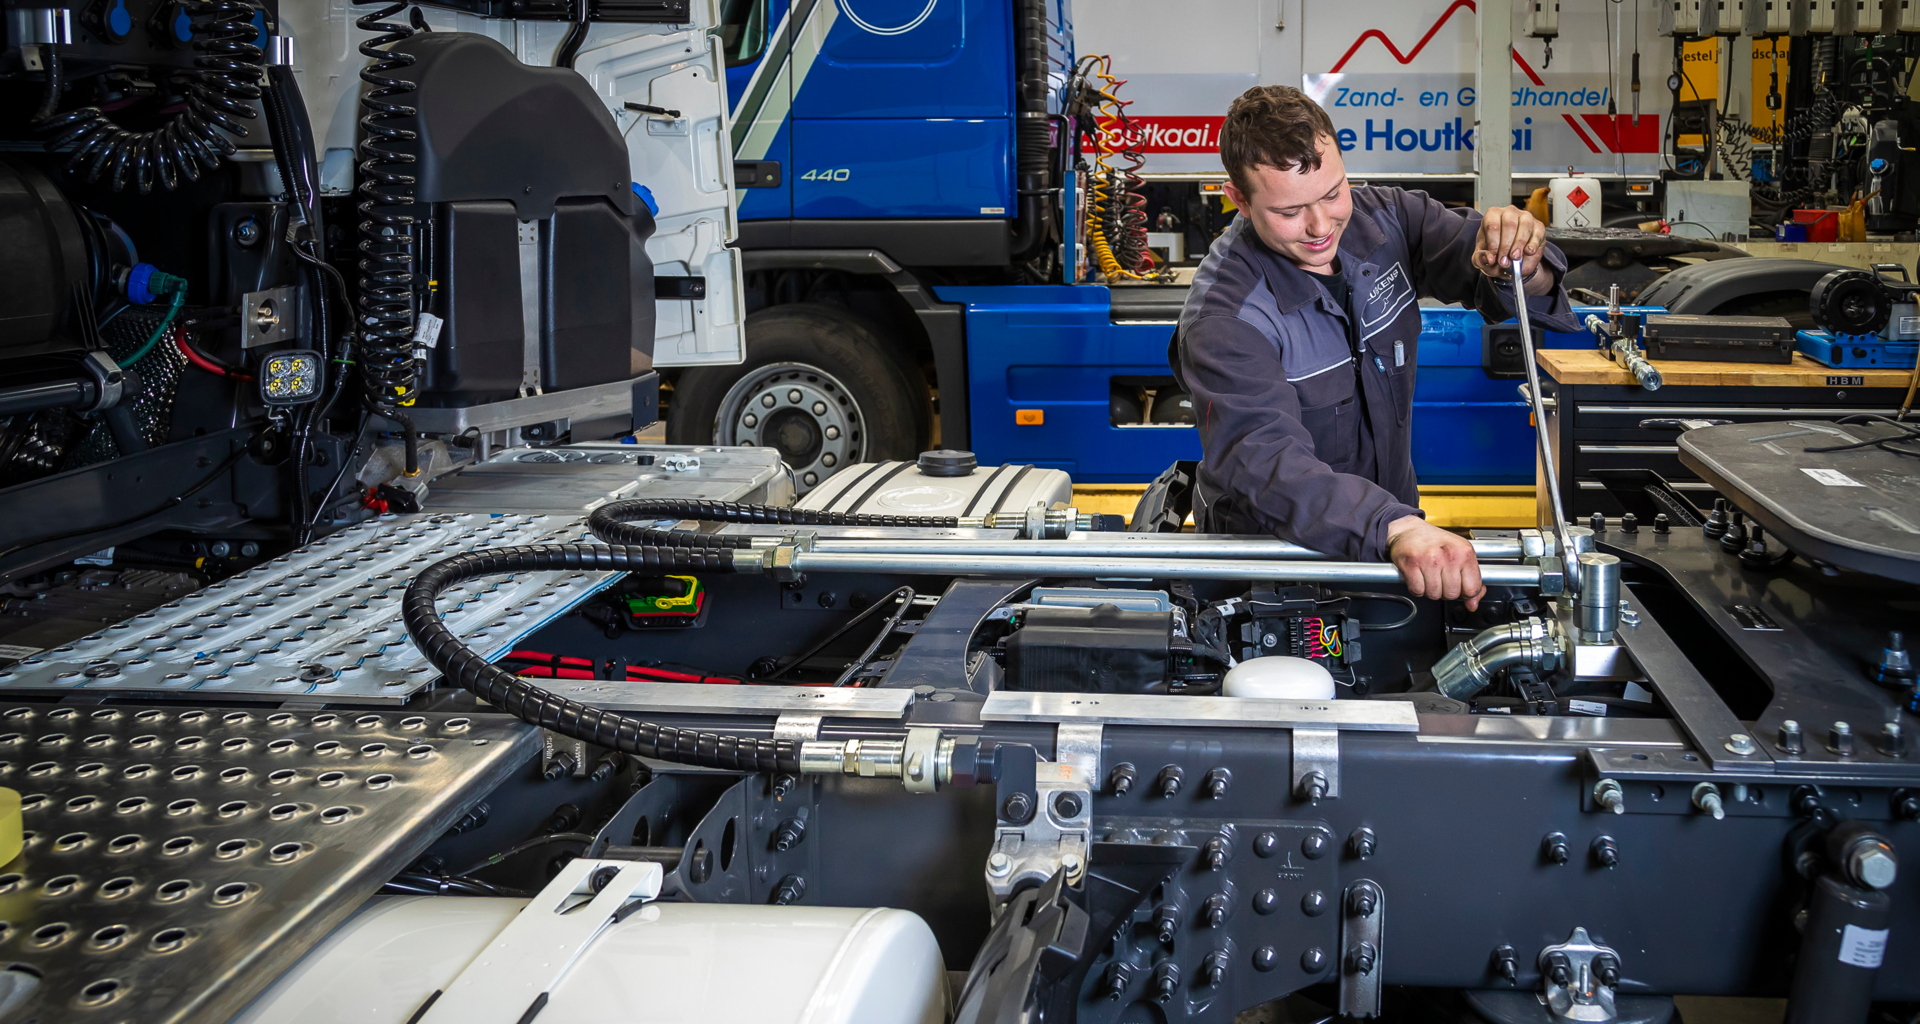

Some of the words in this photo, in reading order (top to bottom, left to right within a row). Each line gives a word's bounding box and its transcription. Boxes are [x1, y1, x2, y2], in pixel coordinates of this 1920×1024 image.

[1683, 49, 1712, 62] estel
[1752, 48, 1789, 62] dsca
[1334, 88, 1404, 107] Zand-
[1419, 91, 1449, 107] en
[1457, 87, 1609, 107] Gdhandel
[1081, 123, 1222, 147] .houtkaai.
[1338, 127, 1357, 151] e
[1365, 117, 1532, 151] Houtki
[801, 169, 850, 182] 440
[1369, 268, 1399, 299] UKENS
[1829, 377, 1861, 385] HBM
